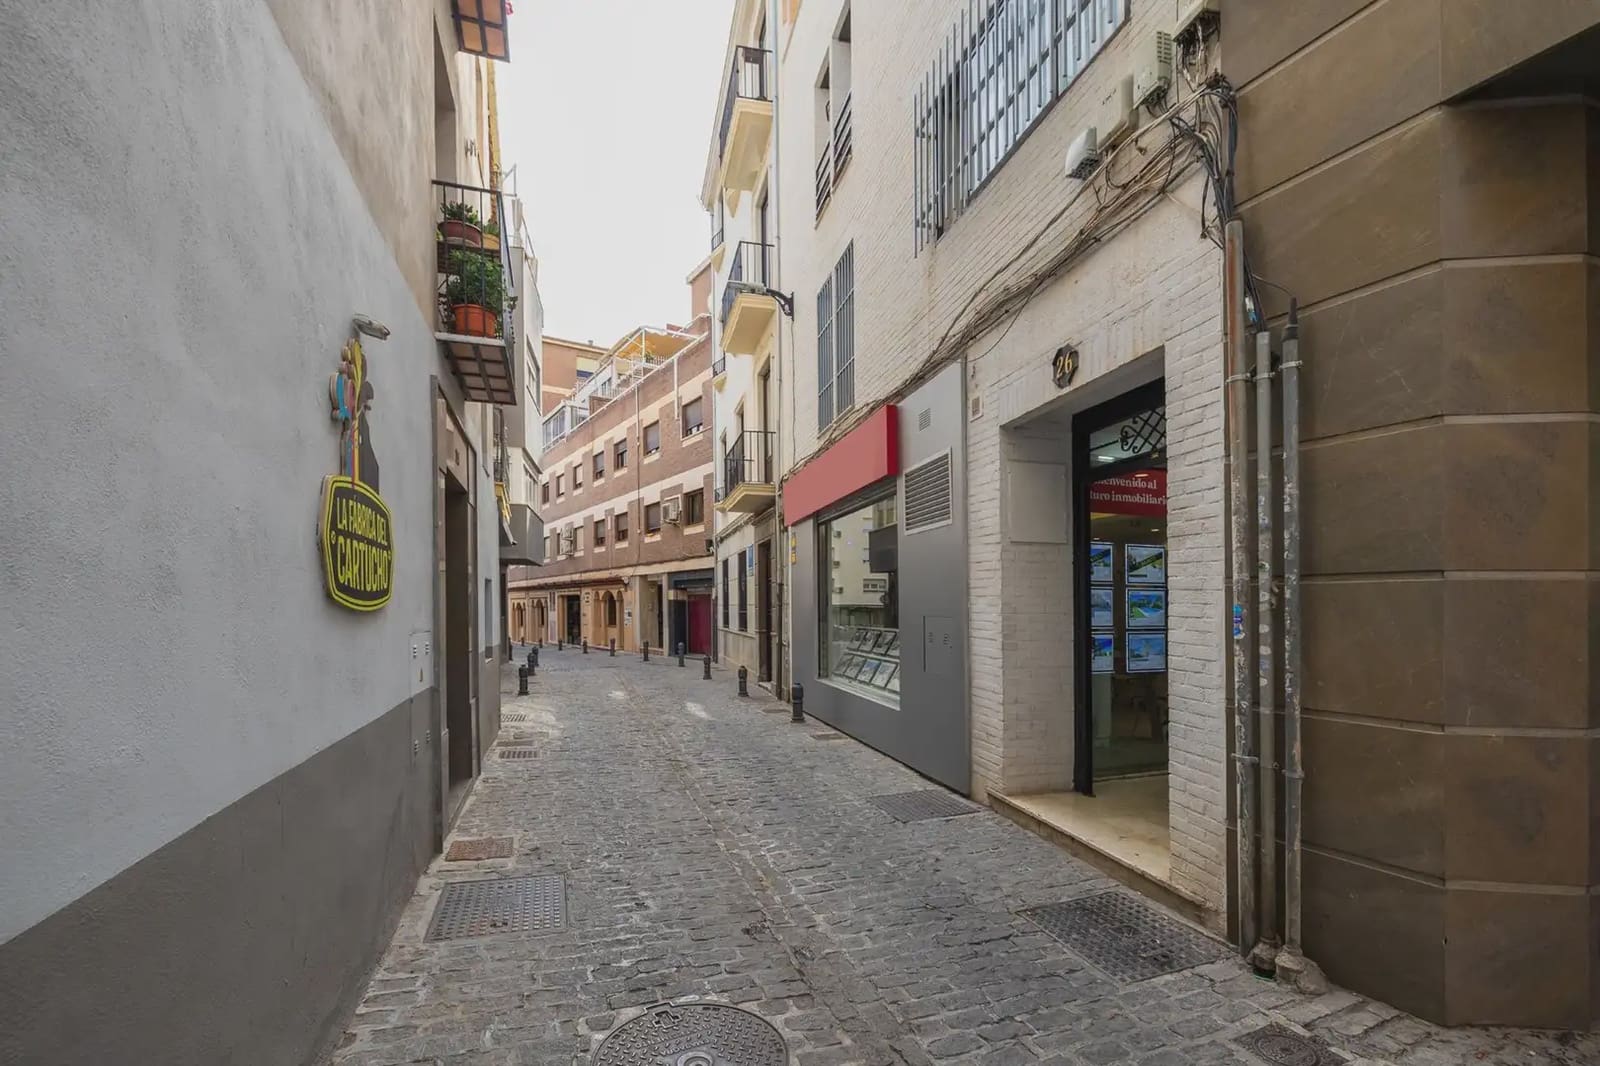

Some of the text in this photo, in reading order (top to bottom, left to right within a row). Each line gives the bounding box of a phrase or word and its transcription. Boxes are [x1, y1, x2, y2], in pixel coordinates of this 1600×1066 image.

[1056, 352, 1072, 376] 26
[1094, 477, 1158, 489] envenido al
[1112, 491, 1167, 505] inmobiliari
[337, 497, 347, 531] LA
[377, 514, 388, 546] DEL
[338, 535, 388, 591] CARTUCHO
